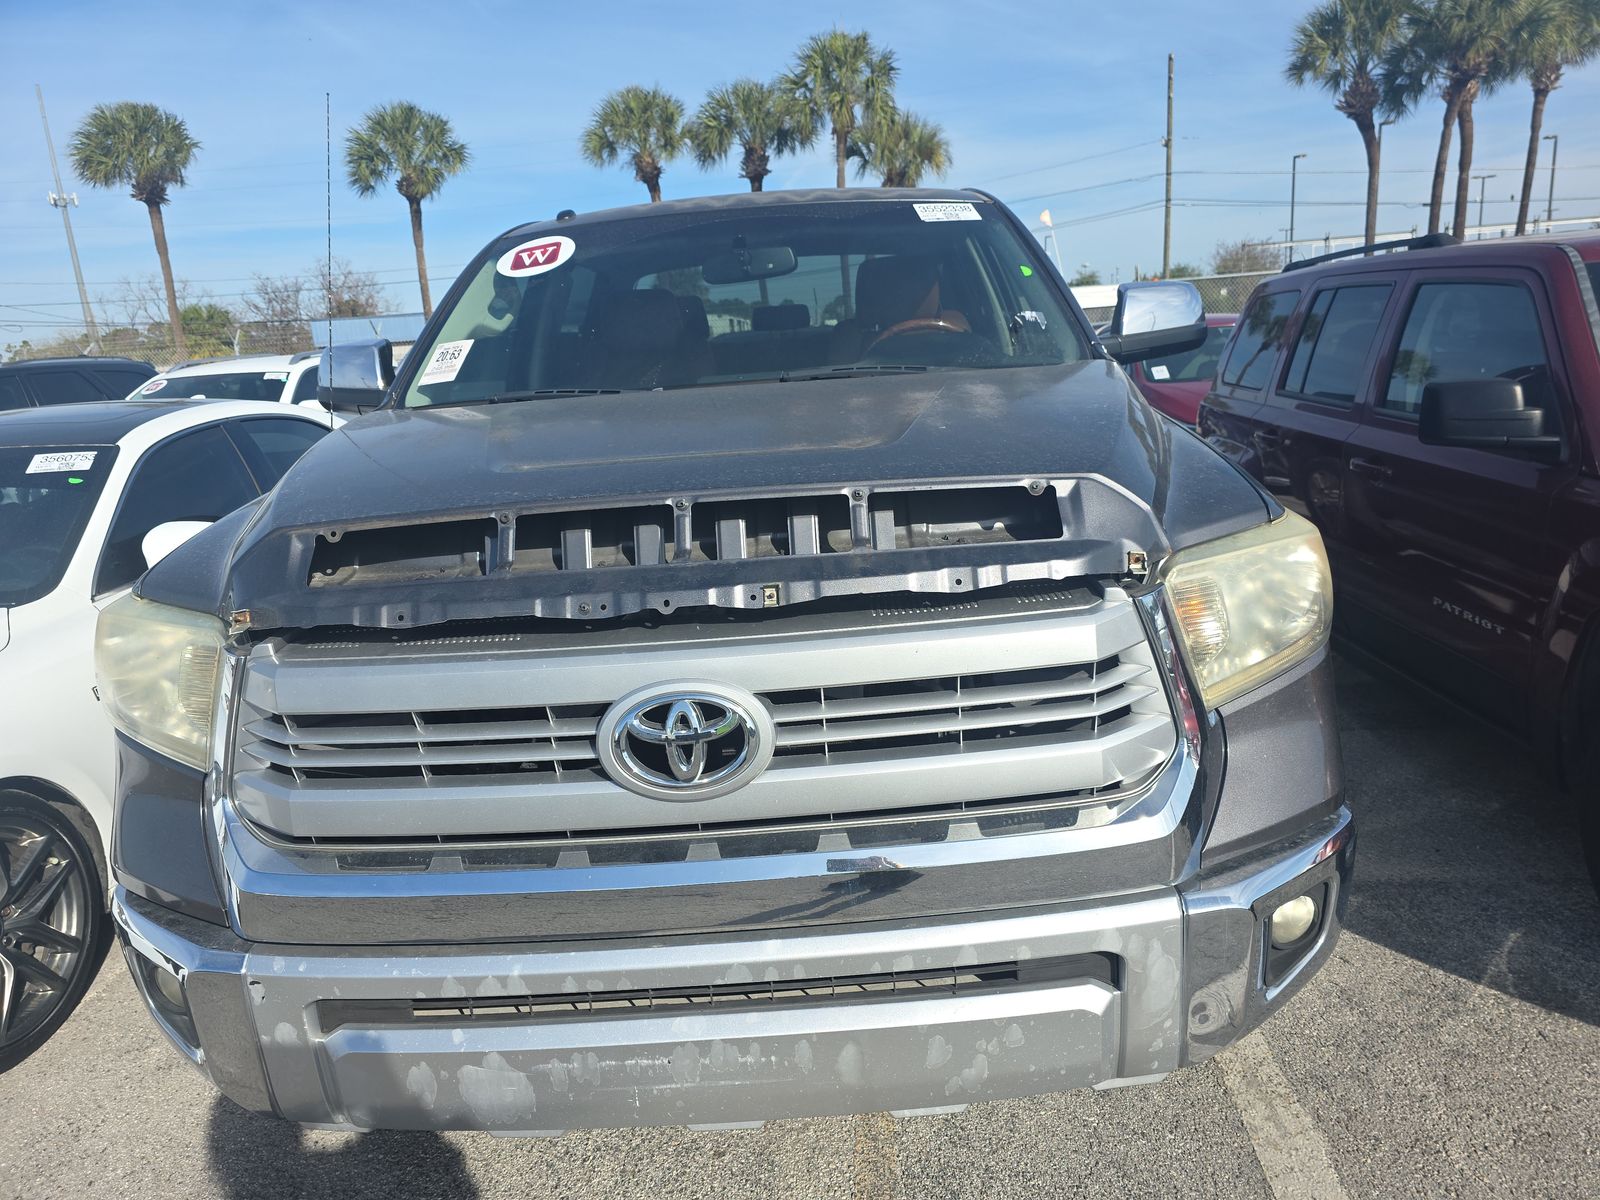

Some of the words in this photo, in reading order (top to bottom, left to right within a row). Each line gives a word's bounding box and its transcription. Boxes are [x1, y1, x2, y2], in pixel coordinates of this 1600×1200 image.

[519, 246, 557, 266] W
[435, 348, 463, 363] 20:63
[1433, 596, 1504, 635] PATRIOT
